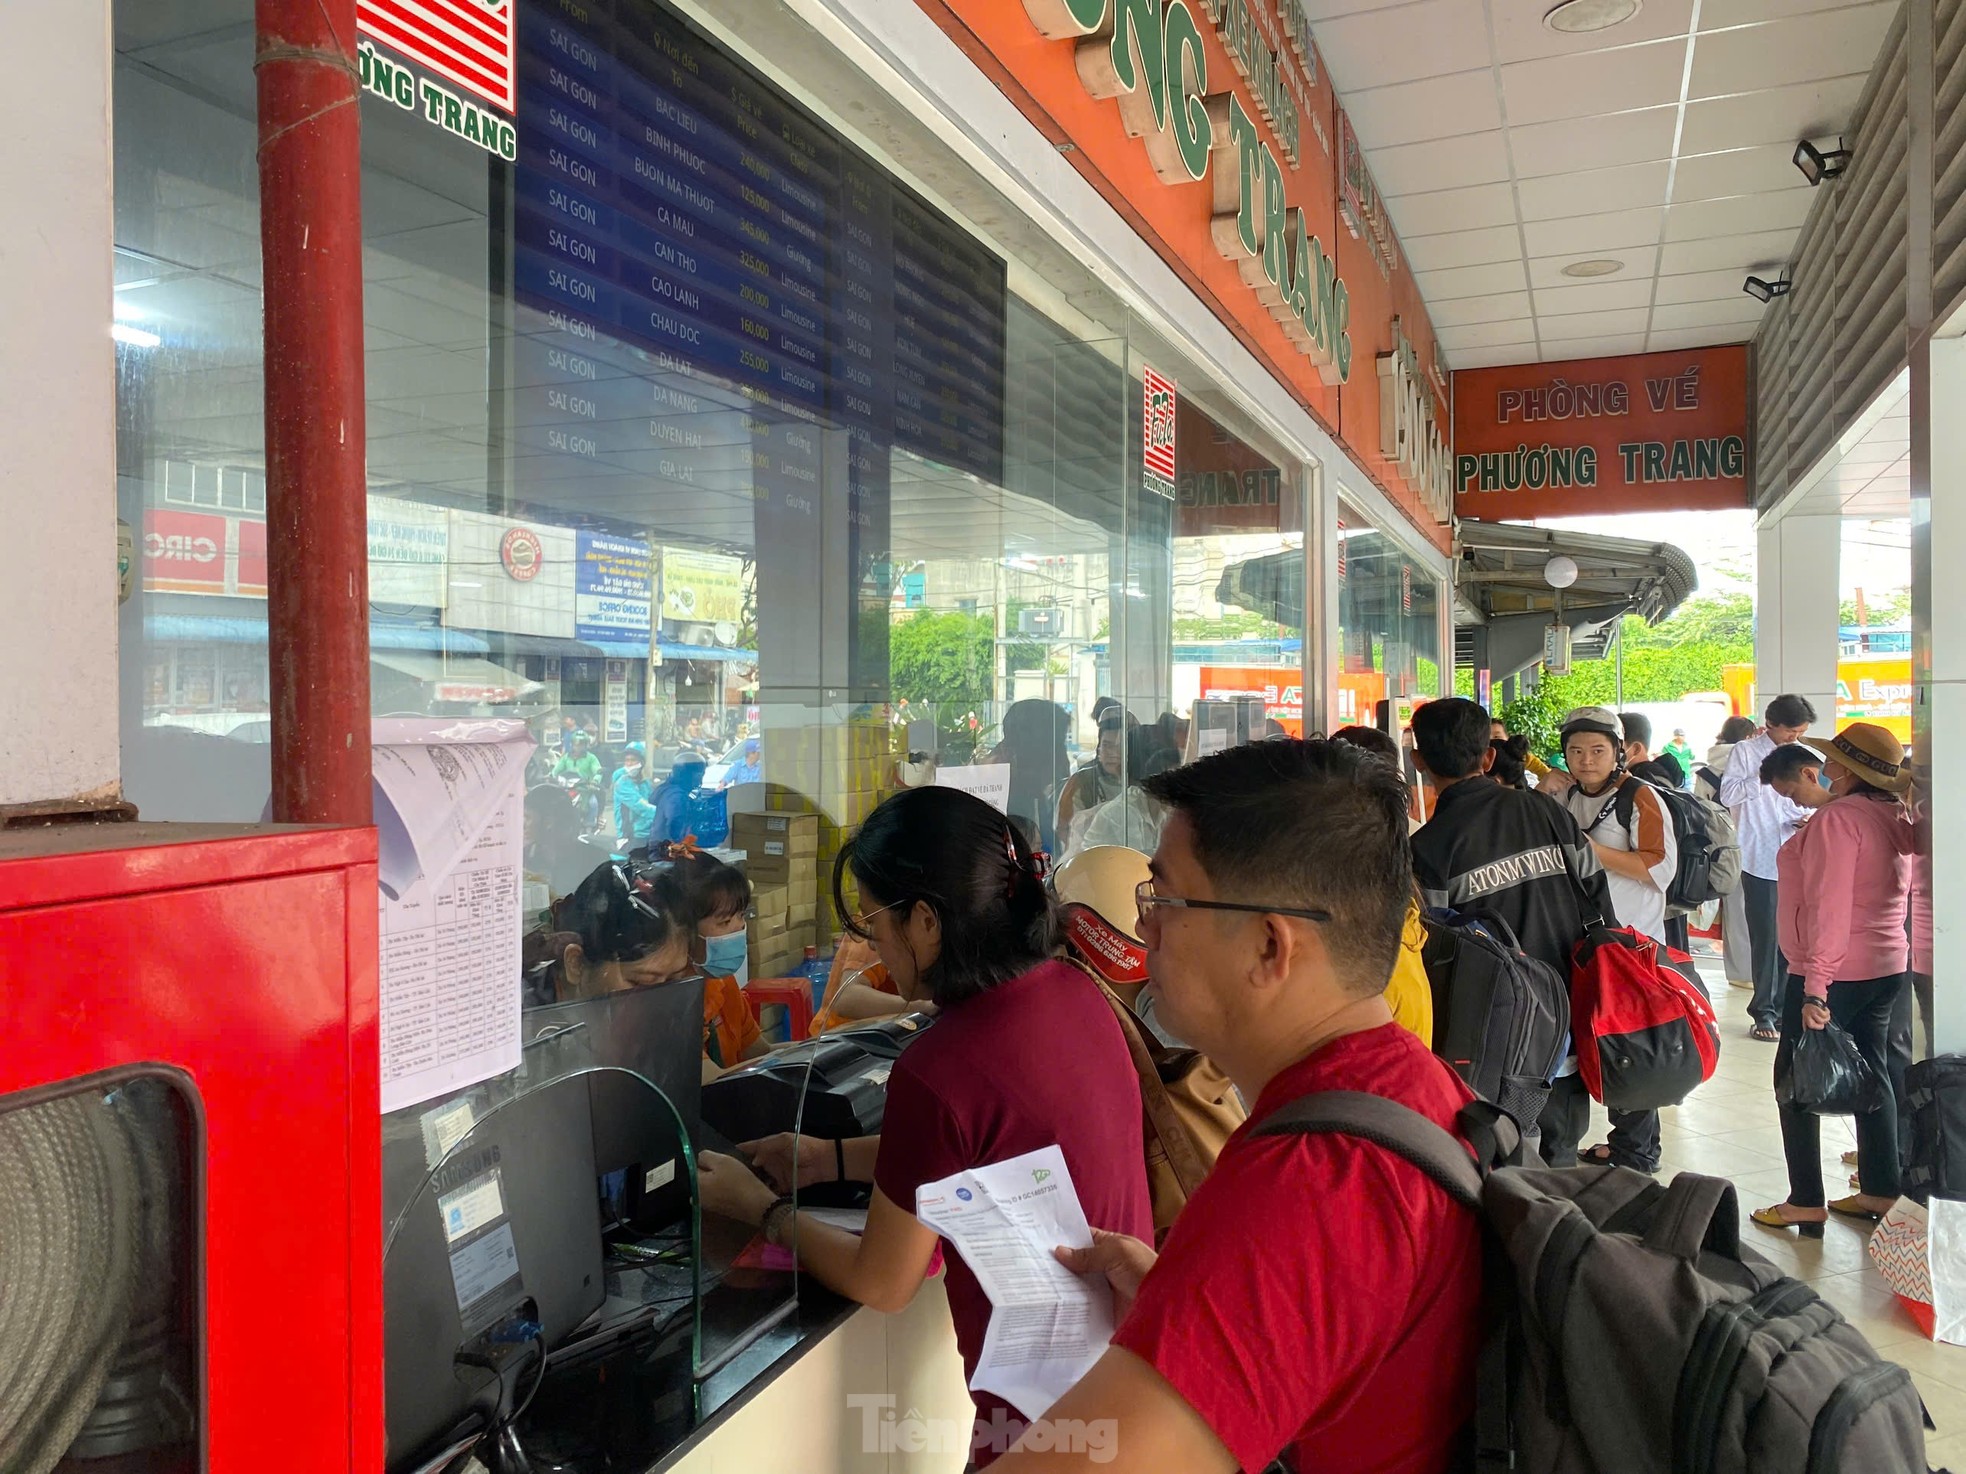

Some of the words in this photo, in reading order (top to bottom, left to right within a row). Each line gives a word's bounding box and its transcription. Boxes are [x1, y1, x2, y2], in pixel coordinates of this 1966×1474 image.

[550, 28, 568, 52] SAI
[571, 42, 597, 71] GON
[550, 67, 568, 92] SAI
[571, 82, 597, 110] GON
[419, 78, 517, 161] TRANG
[550, 108, 568, 132] SAI
[571, 120, 597, 148] GON
[655, 97, 676, 122] BAC
[677, 107, 697, 135] LIEU
[645, 126, 670, 153] BINH
[673, 143, 706, 175] PHUOC
[550, 149, 568, 173] SAI
[571, 160, 596, 188] GON
[634, 157, 664, 187] BUON
[667, 176, 682, 197] MA
[685, 185, 715, 215] THUOT
[741, 184, 770, 213] 125,000
[549, 189, 567, 213] SAI
[570, 200, 596, 226] GON
[657, 207, 670, 226] CA
[673, 214, 694, 237] MAU
[781, 209, 816, 242] Limousine
[1230, 91, 1351, 384] TRANG
[549, 229, 567, 252] SAI
[570, 239, 596, 265] GON
[654, 241, 675, 263] CAN
[677, 251, 697, 274] THO
[740, 250, 770, 277] 325,000
[549, 270, 567, 291] SAI
[570, 279, 596, 303] GON
[651, 276, 671, 298] CAO
[674, 287, 699, 311] LANH
[739, 283, 769, 309] 200,000
[781, 272, 816, 303] Limousine
[549, 310, 567, 331] SAI
[570, 318, 595, 342] GON
[650, 312, 677, 335] CHAU
[680, 322, 700, 346] DOC
[740, 317, 769, 341] 160,000
[780, 304, 816, 332] Limousine
[548, 350, 567, 371] SAI
[570, 357, 596, 380] GON
[659, 352, 673, 369] DA
[676, 359, 690, 375] LAT
[740, 350, 769, 374] 255,000
[780, 335, 815, 363] Limousine
[780, 366, 815, 393] Limousine
[1497, 378, 1629, 424] PHÒNG
[1644, 365, 1700, 413] VÉ
[548, 390, 567, 411] SAI
[570, 397, 596, 419] GON
[653, 385, 667, 403] DA
[670, 392, 697, 413] NANG
[780, 399, 816, 423] Limousine
[847, 395, 857, 408] SAI
[858, 401, 871, 416] GON
[548, 430, 567, 450] SAI
[570, 436, 596, 457] GON
[650, 420, 682, 445] DUYEN
[685, 432, 701, 449] HAI
[660, 459, 675, 476] GIA
[678, 464, 693, 482] LAI
[780, 460, 816, 483] Limousine
[1456, 443, 1598, 494] PHƯƠNG
[1618, 435, 1745, 485] TRANG
[1075, 915, 1099, 940] MOTOR
[1098, 937, 1125, 959] TRUNG
[431, 1145, 500, 1194] SAMSUNG
